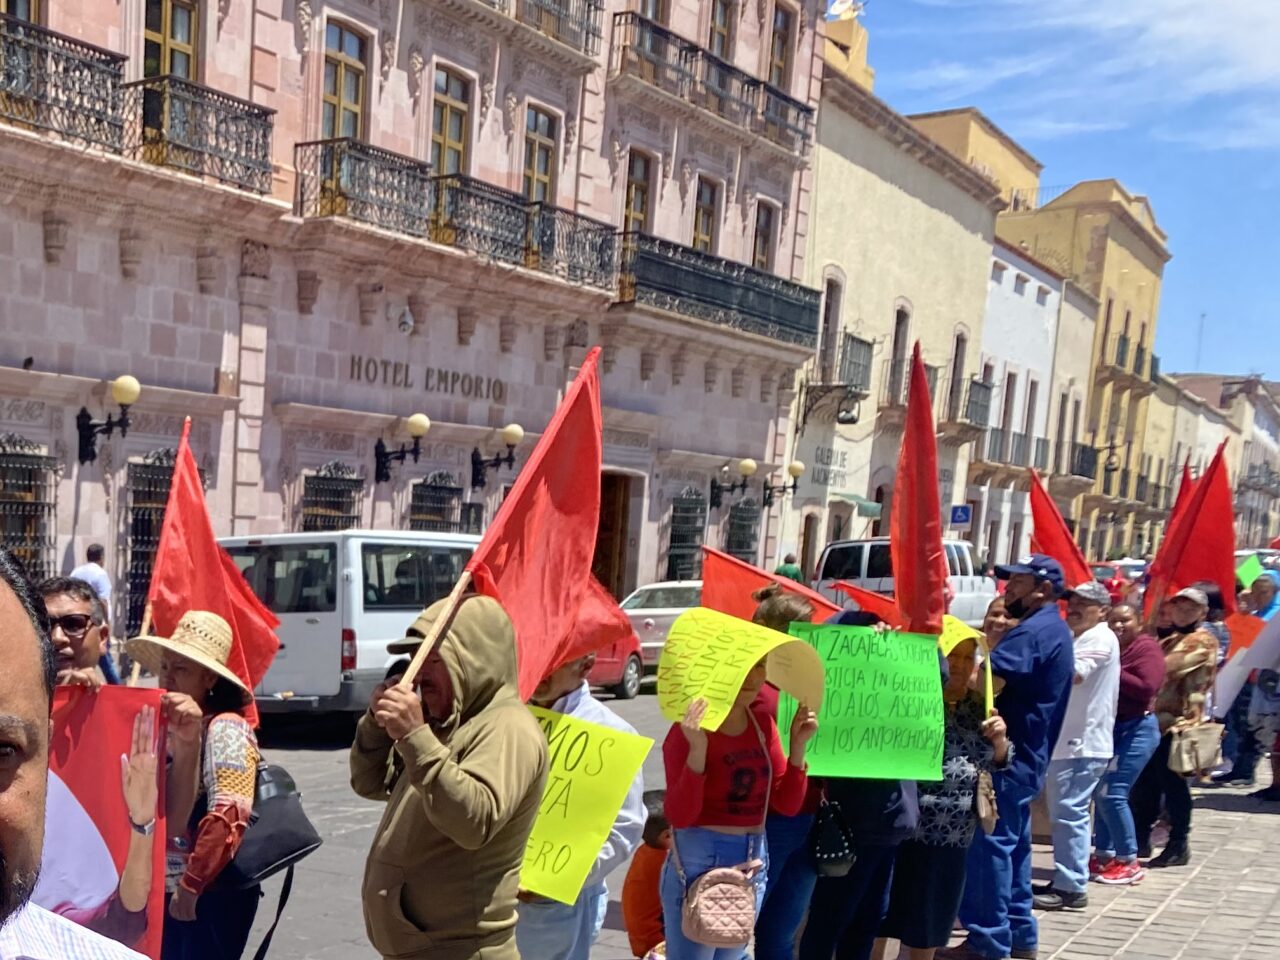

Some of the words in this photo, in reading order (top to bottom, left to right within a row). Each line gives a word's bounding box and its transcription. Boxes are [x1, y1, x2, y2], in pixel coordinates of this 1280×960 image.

[350, 354, 414, 389] HOTEL
[425, 366, 504, 401] EMPORIO
[825, 667, 866, 689] STICIA
[536, 716, 616, 777] MOS
